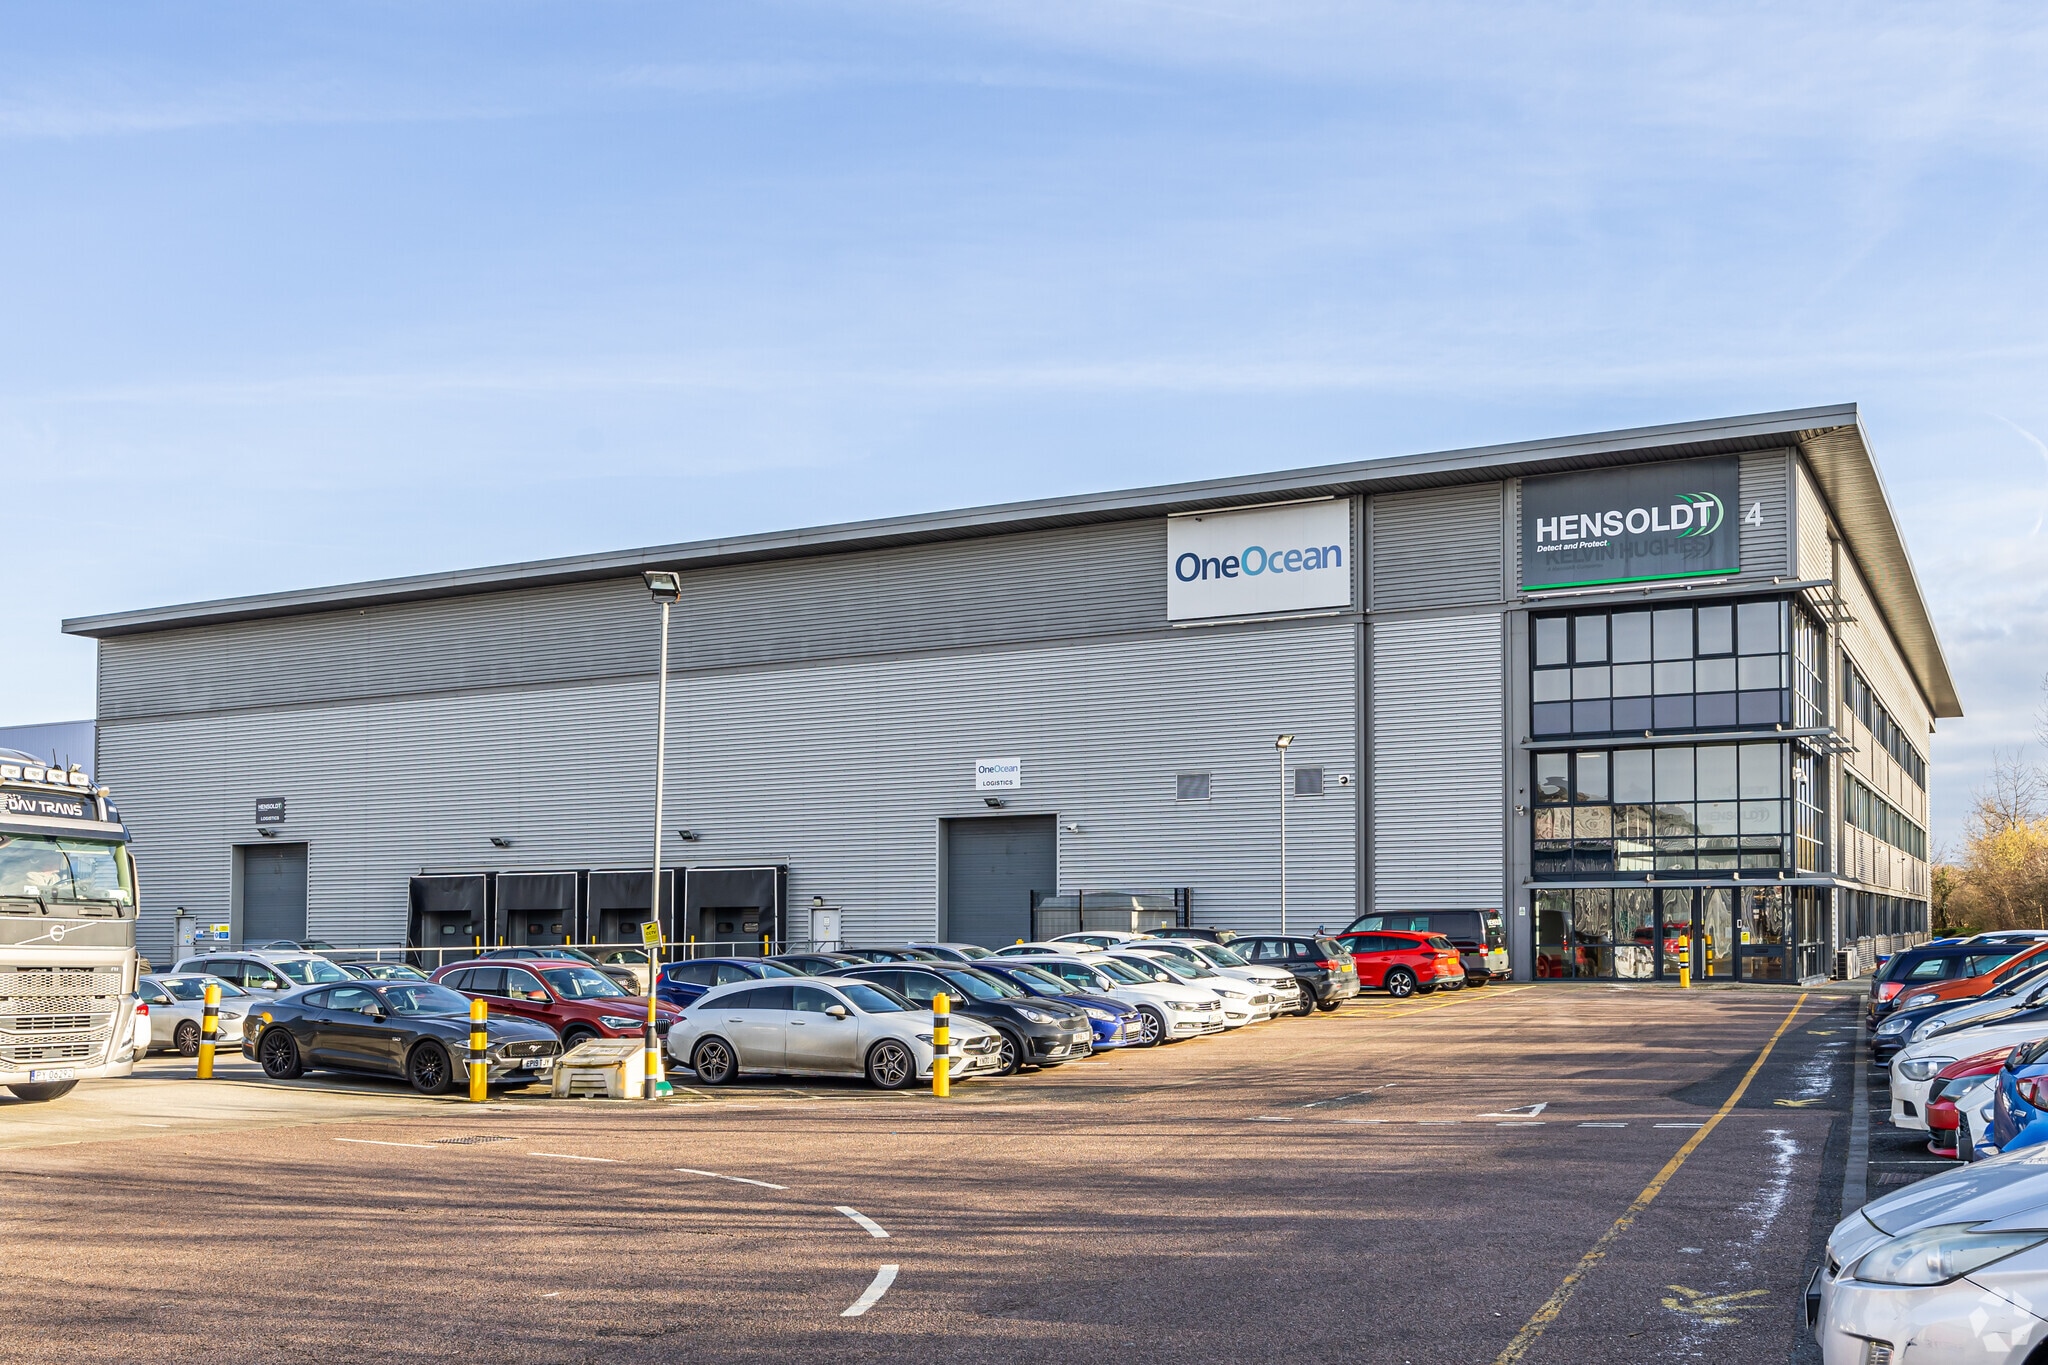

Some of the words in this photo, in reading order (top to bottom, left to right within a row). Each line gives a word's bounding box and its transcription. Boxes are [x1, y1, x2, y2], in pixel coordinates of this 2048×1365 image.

[1537, 501, 1714, 542] HENSOLDT
[1744, 502, 1764, 527] 4
[1537, 543, 1562, 552] Detect
[1563, 542, 1578, 550] and
[1175, 545, 1342, 582] OneOcean
[978, 765, 1018, 774] OneOcean
[9, 799, 36, 812] DAV
[39, 801, 82, 816] TRANS
